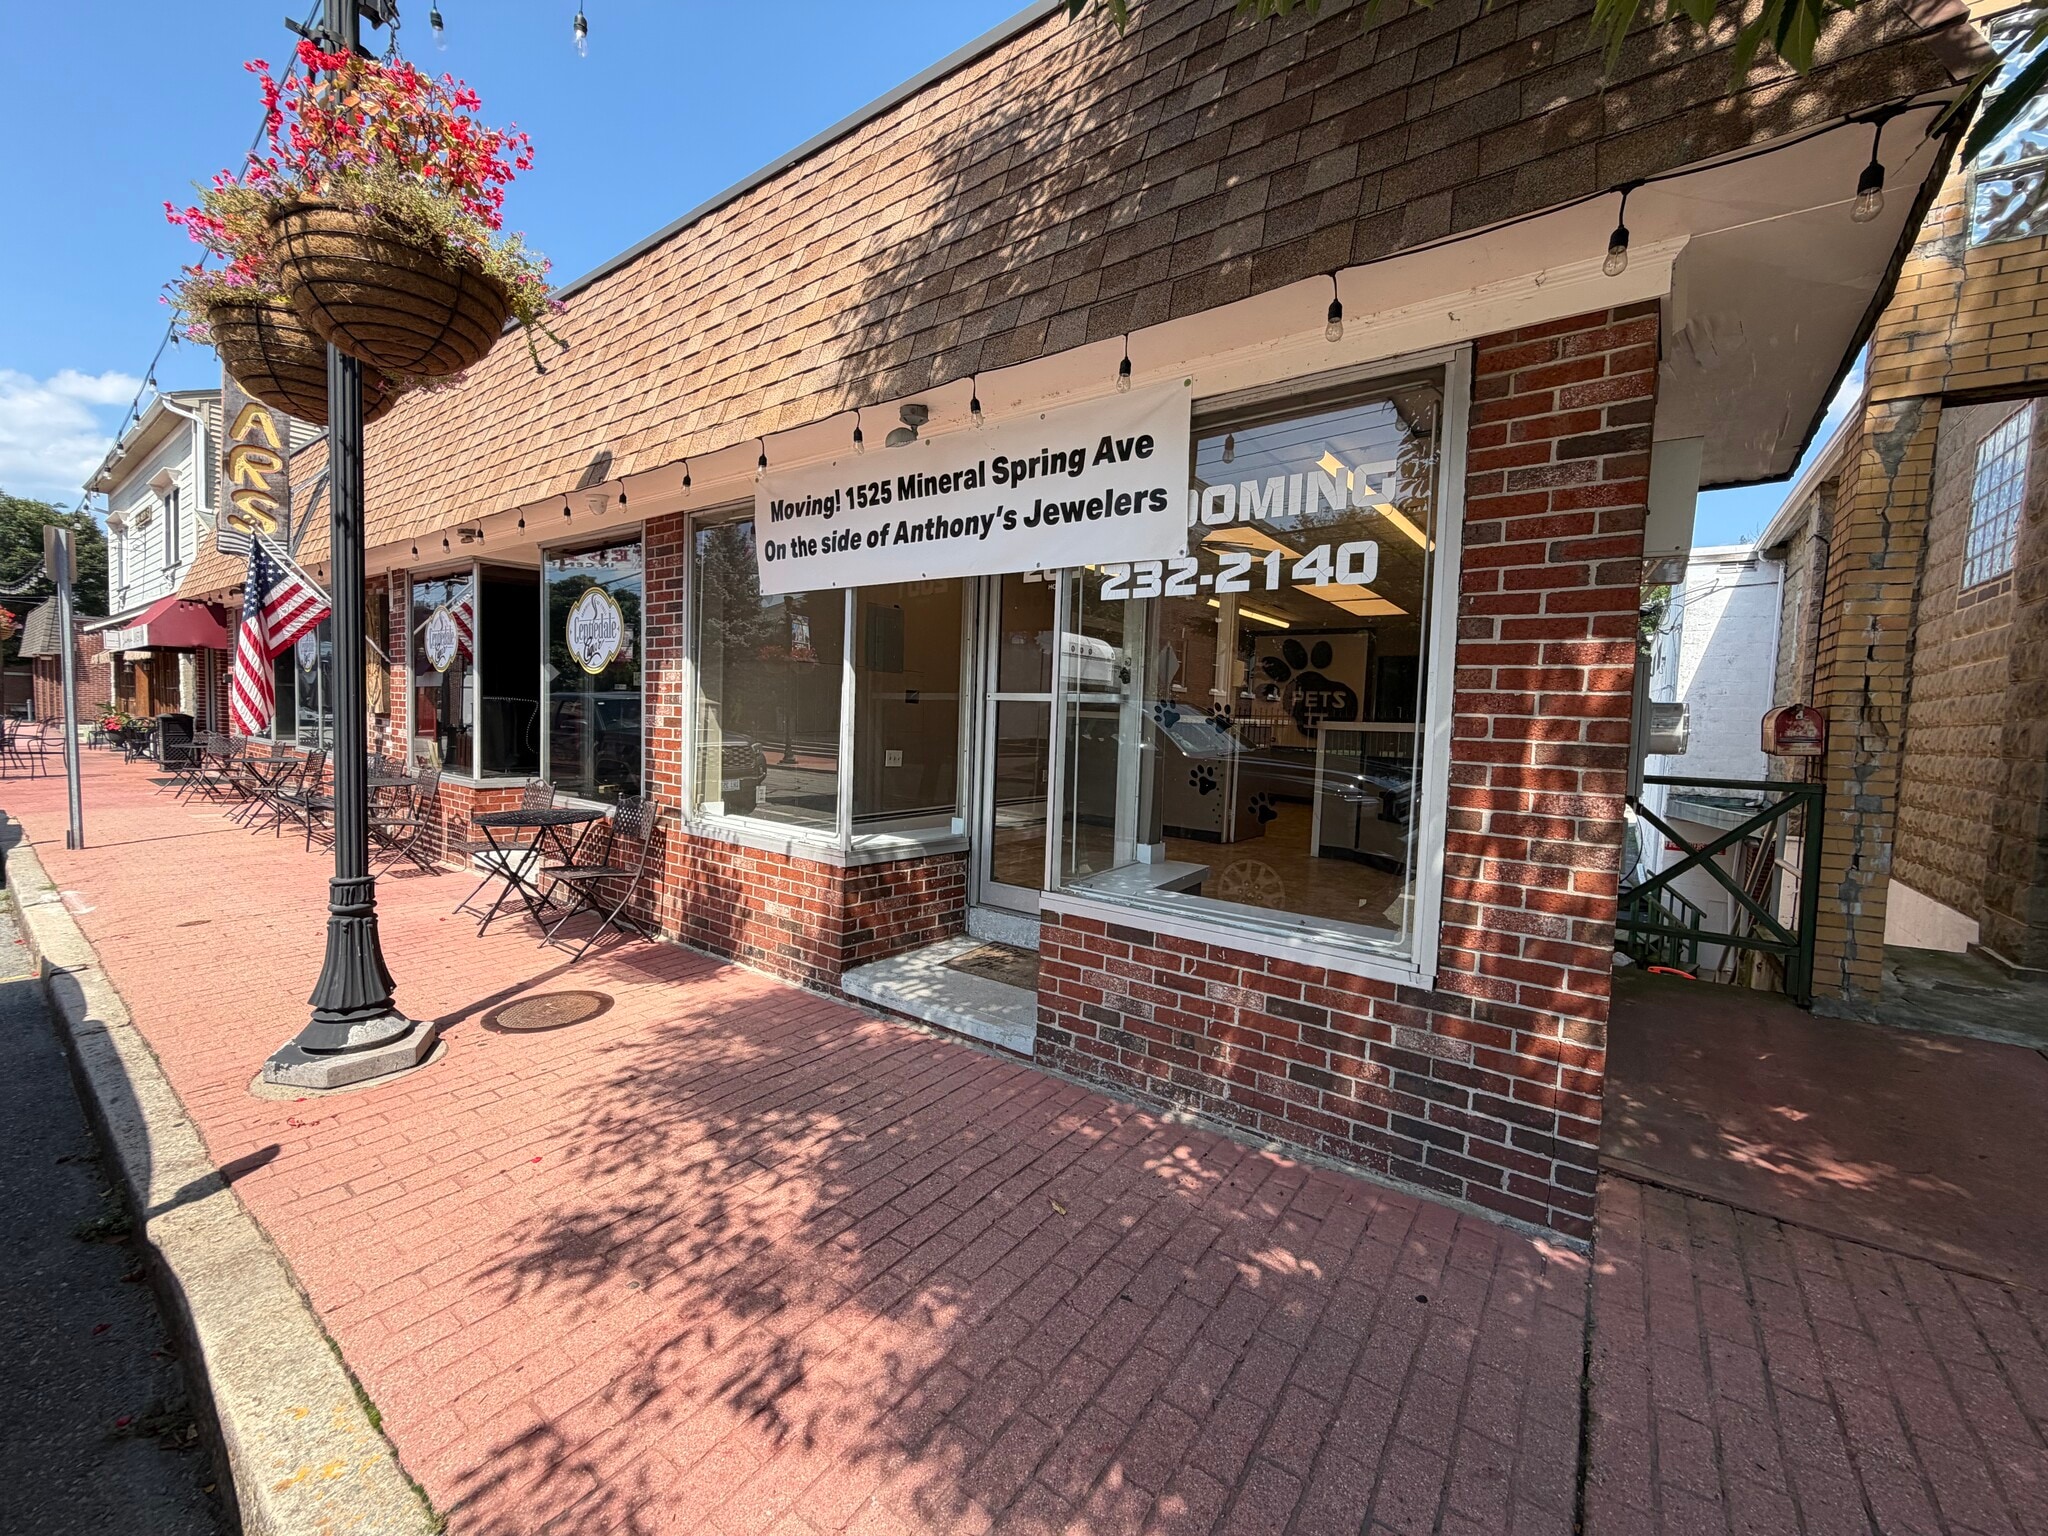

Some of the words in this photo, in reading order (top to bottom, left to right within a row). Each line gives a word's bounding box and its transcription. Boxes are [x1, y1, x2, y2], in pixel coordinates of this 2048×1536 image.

[228, 382, 284, 536] ARS
[771, 489, 841, 522] Moving!
[845, 480, 892, 510] 1525
[897, 460, 985, 501] Mineral
[992, 447, 1086, 489] Spring
[1092, 434, 1154, 466] Ave
[765, 540, 786, 562] On
[790, 536, 817, 558] the
[821, 529, 862, 553] side
[867, 523, 890, 548] of
[893, 506, 1017, 545] Anthony's
[1023, 488, 1168, 528] Jewelers
[1101, 540, 1378, 600] 232-2140
[1292, 690, 1346, 709] PETS
